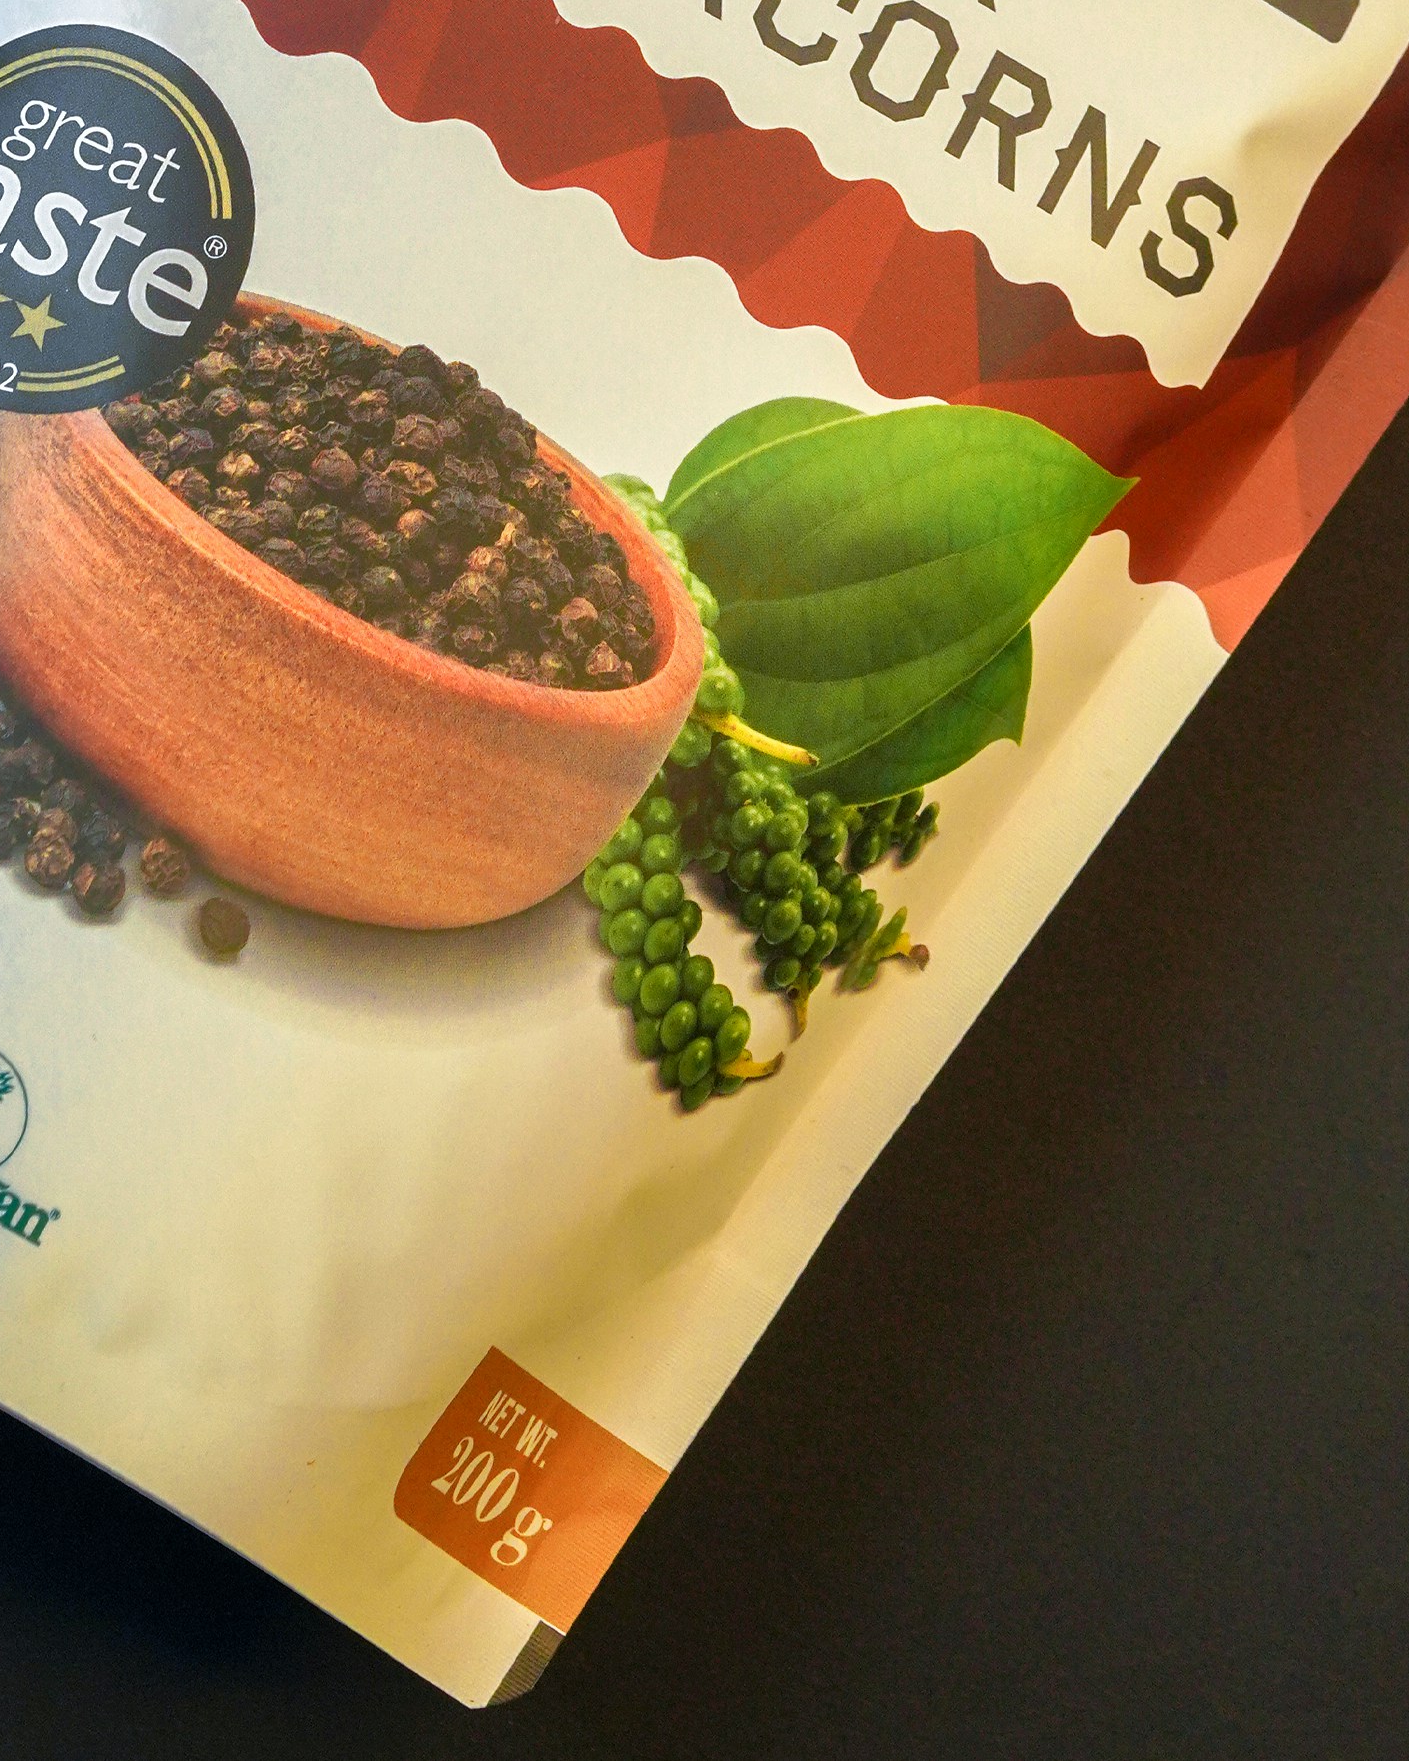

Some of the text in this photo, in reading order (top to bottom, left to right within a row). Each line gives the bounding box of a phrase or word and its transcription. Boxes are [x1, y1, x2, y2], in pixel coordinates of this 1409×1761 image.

[1, 99, 181, 203] great
[478, 1390, 558, 1468] NET WT.
[431, 1436, 553, 1566] 200 g
